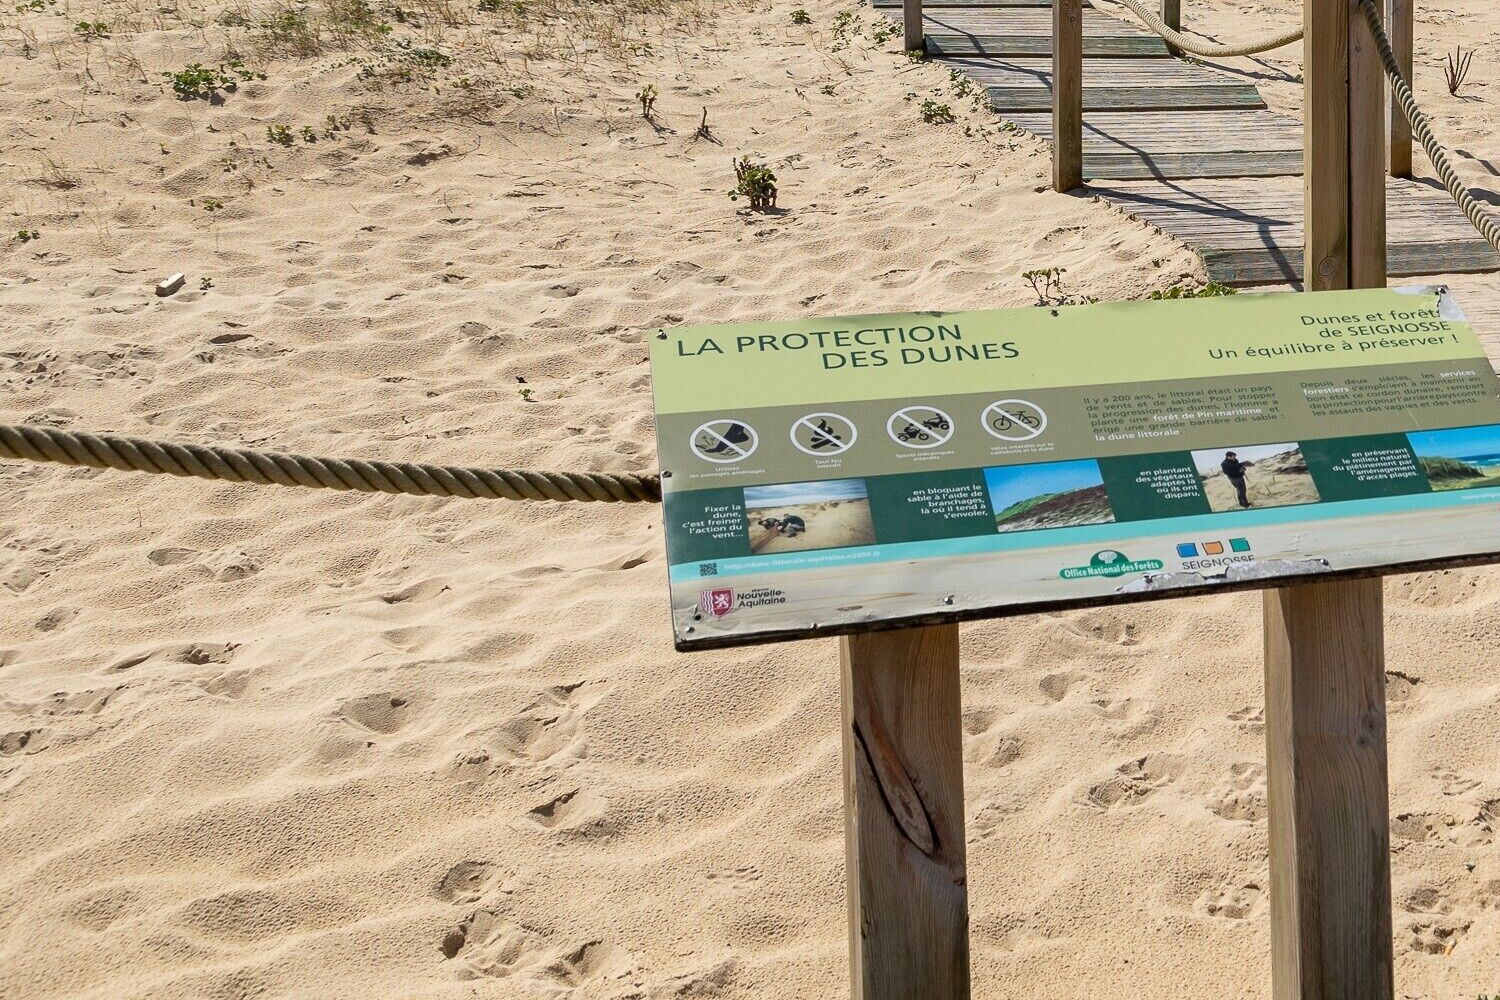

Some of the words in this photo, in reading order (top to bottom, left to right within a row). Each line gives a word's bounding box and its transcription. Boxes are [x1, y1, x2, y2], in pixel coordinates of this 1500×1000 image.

[1300, 314, 1360, 326] Dunes
[1366, 312, 1386, 322] et
[1319, 327, 1342, 338] de
[1347, 320, 1452, 336] SEIGNOSSE
[677, 339, 723, 357] LA
[736, 324, 962, 353] PROTECTION
[1208, 348, 1238, 360] Un
[1245, 341, 1336, 360] équilibre
[1342, 340, 1353, 351] à
[1358, 335, 1446, 353] préserver
[1451, 334, 1459, 344] !
[822, 350, 888, 370] DES
[900, 341, 1020, 365] DUNES
[1344, 378, 1368, 386] deux
[1440, 370, 1476, 378] services
[1303, 386, 1350, 395] forestiers
[1420, 377, 1466, 386] maintenir
[1366, 390, 1400, 398] cordon
[1447, 383, 1484, 391] rempart
[1112, 394, 1131, 402] 200
[1170, 389, 1204, 398] littoral
[1234, 386, 1247, 394] un
[1250, 384, 1272, 393] pays
[1238, 392, 1276, 400] stopper
[1102, 408, 1162, 418] progression
[1329, 408, 1364, 416] assauts
[1385, 403, 1418, 412] vagues
[1091, 418, 1125, 427] planté
[1153, 414, 1180, 422] forêt
[1182, 412, 1196, 420] de
[1197, 411, 1214, 419] Pin
[1216, 408, 1262, 417] maritime
[1093, 426, 1120, 434] érigé
[1148, 421, 1186, 430] grande
[1190, 418, 1230, 426] barrière
[1251, 414, 1278, 422] sable
[1095, 434, 1106, 442] la
[1108, 432, 1136, 441] dune
[1364, 448, 1408, 457] préservant
[1346, 460, 1398, 470] piétinement
[1352, 456, 1378, 464] milieu
[1154, 467, 1192, 476] plantant
[1350, 465, 1416, 476] l'aménagement
[1150, 480, 1186, 488] adaptés
[928, 486, 970, 494] bloquant
[928, 498, 985, 507] branchages,
[944, 510, 988, 519] s'envoler,
[708, 518, 742, 526] freiner
[690, 526, 726, 534] l'action
[1064, 569, 1088, 578] Office
[1088, 564, 1120, 576] National
[1120, 564, 1134, 572] des
[1134, 561, 1160, 571] Forêts
[737, 590, 786, 600] Nouvelle-
[738, 596, 786, 608] Aquitaine
